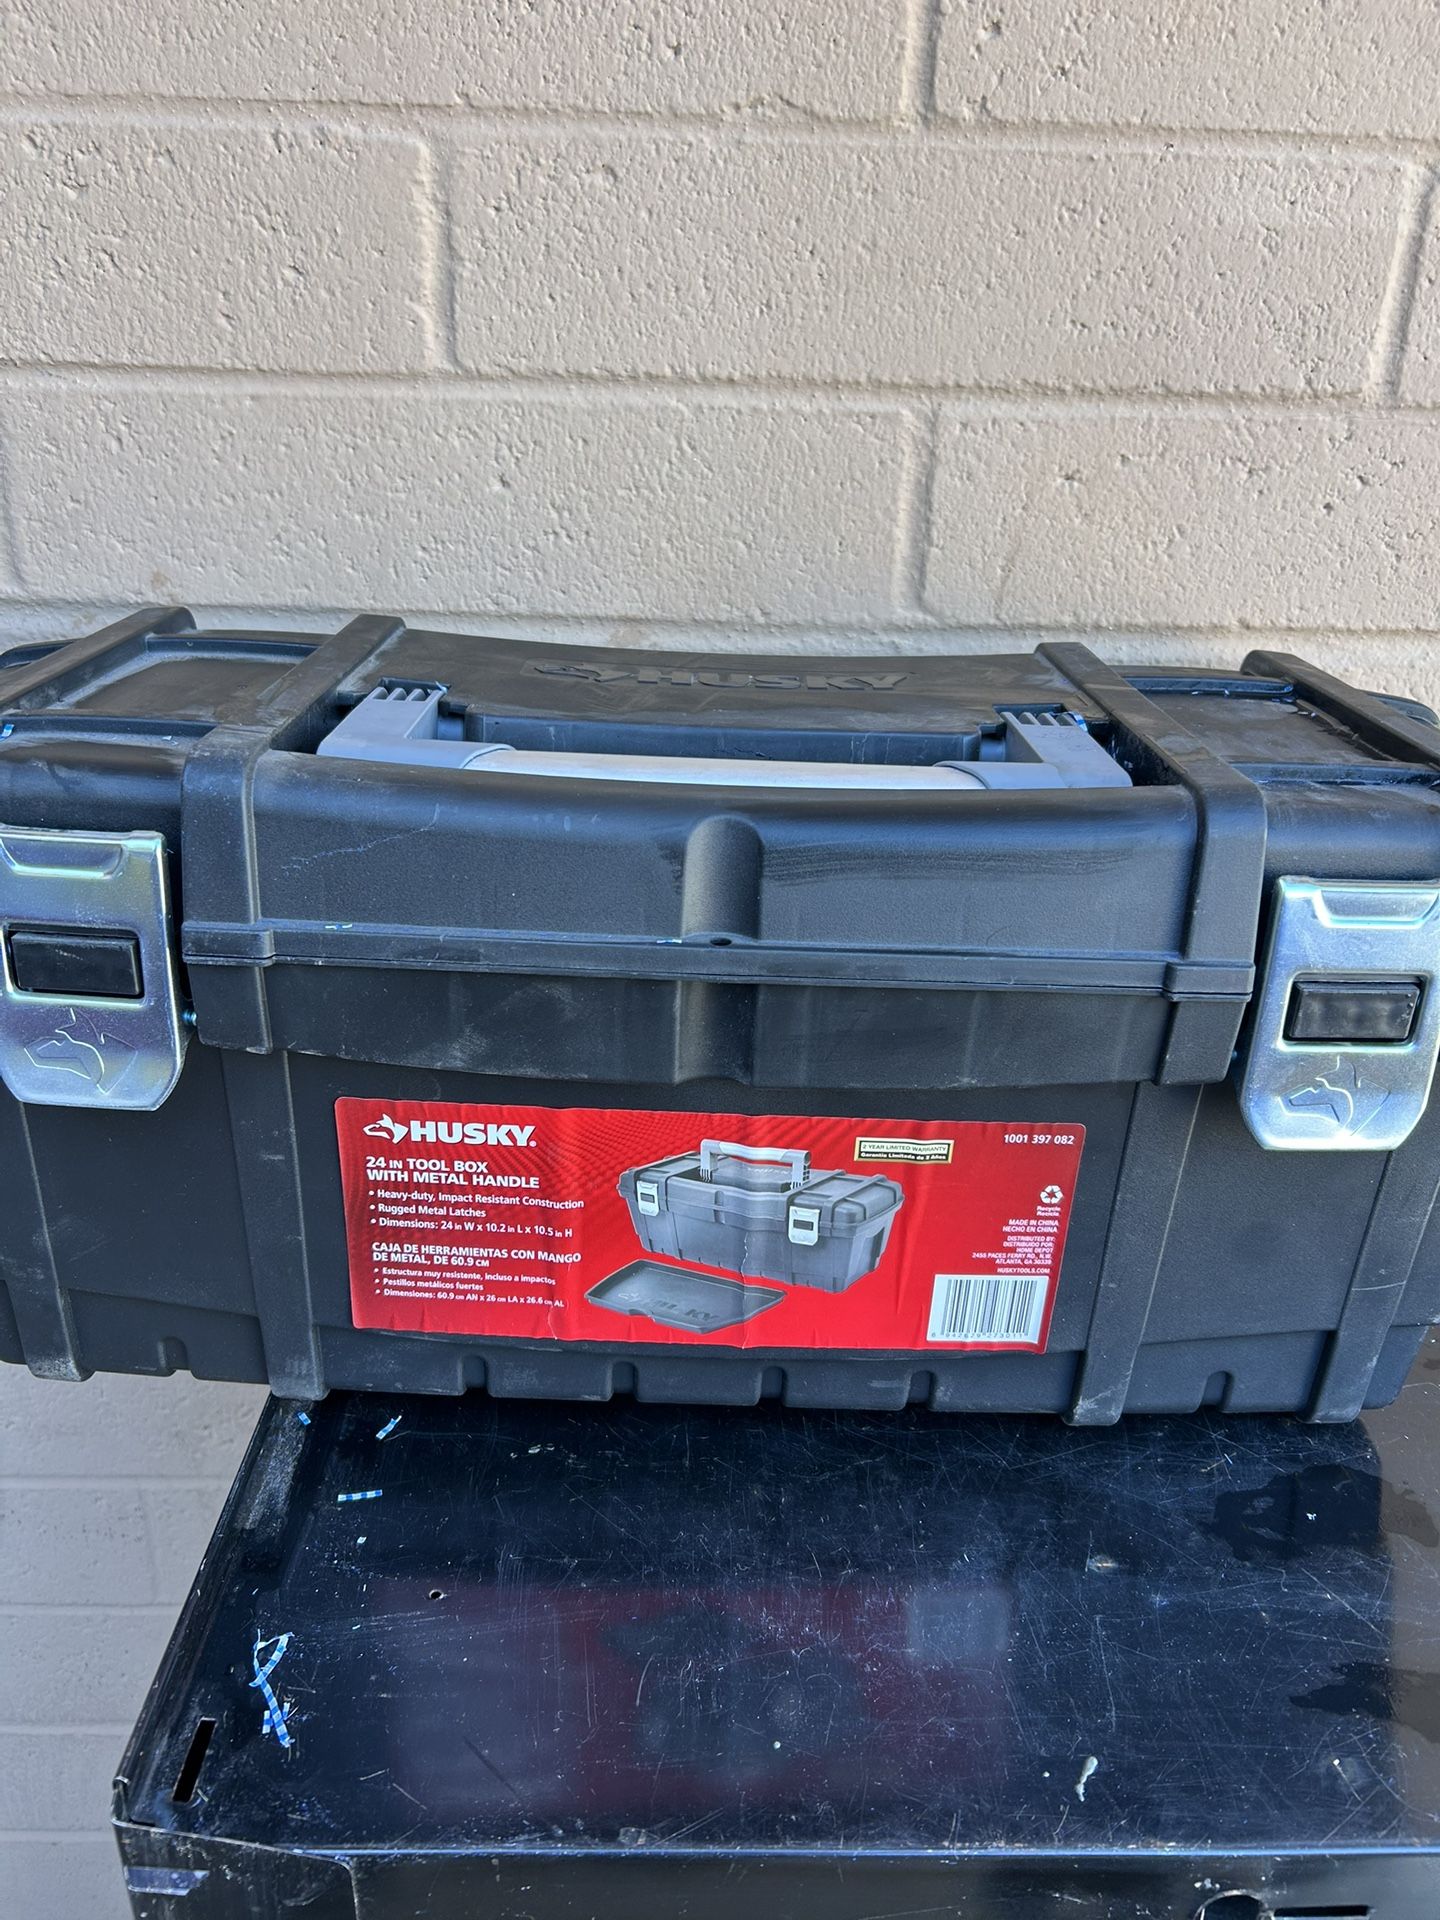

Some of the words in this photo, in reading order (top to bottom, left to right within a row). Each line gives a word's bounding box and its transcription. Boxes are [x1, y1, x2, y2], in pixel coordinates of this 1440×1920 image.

[637, 671, 909, 690] HUSKY
[1003, 1134, 1028, 1143] 1001
[1031, 1134, 1051, 1144] 397
[1054, 1135, 1075, 1144] 082
[366, 1156, 386, 1168] 24
[389, 1160, 403, 1169] IN
[406, 1158, 450, 1171] TOOL
[454, 1160, 488, 1173] BOX
[366, 1169, 409, 1182] WITH
[413, 1171, 468, 1185] METAL
[472, 1174, 540, 1189] HANDLE
[377, 1189, 436, 1202] Heavy-duty,
[438, 1192, 473, 1204] Impact
[475, 1194, 520, 1205] Resistant
[522, 1196, 585, 1210] Construction
[378, 1203, 416, 1215] Rugged
[418, 1205, 447, 1215] Metal
[449, 1207, 486, 1217] Latches
[379, 1217, 439, 1229] Dimensions:
[441, 1220, 453, 1230] 24
[454, 1223, 462, 1231] in
[464, 1222, 475, 1231] W
[486, 1223, 506, 1233] 10.2
[507, 1225, 515, 1233] in
[517, 1225, 523, 1233] L
[534, 1226, 553, 1236] 10.5
[565, 1229, 573, 1238] H
[372, 1242, 401, 1252] CAJA
[403, 1244, 419, 1253] DE
[421, 1245, 508, 1258] HERRAMIENTAS
[511, 1249, 535, 1260] CON
[538, 1251, 582, 1263] MANGO
[373, 1252, 388, 1261] DE
[390, 1253, 431, 1265] METAL,
[433, 1256, 449, 1265] DE
[451, 1257, 474, 1267] 60.9
[475, 1259, 490, 1267] CM
[382, 1267, 422, 1277] Estructura
[424, 1270, 441, 1279] muy
[442, 1271, 483, 1281] resistente,
[485, 1273, 513, 1282] incluso
[521, 1274, 556, 1285] impactos
[383, 1278, 415, 1287] Pestillos
[417, 1279, 455, 1289] metálicos
[456, 1281, 484, 1290] fuertes
[384, 1288, 435, 1299] Dimensiones:
[437, 1291, 455, 1300] 60.9
[466, 1293, 479, 1301] AN
[526, 1296, 544, 1304] 26.6
